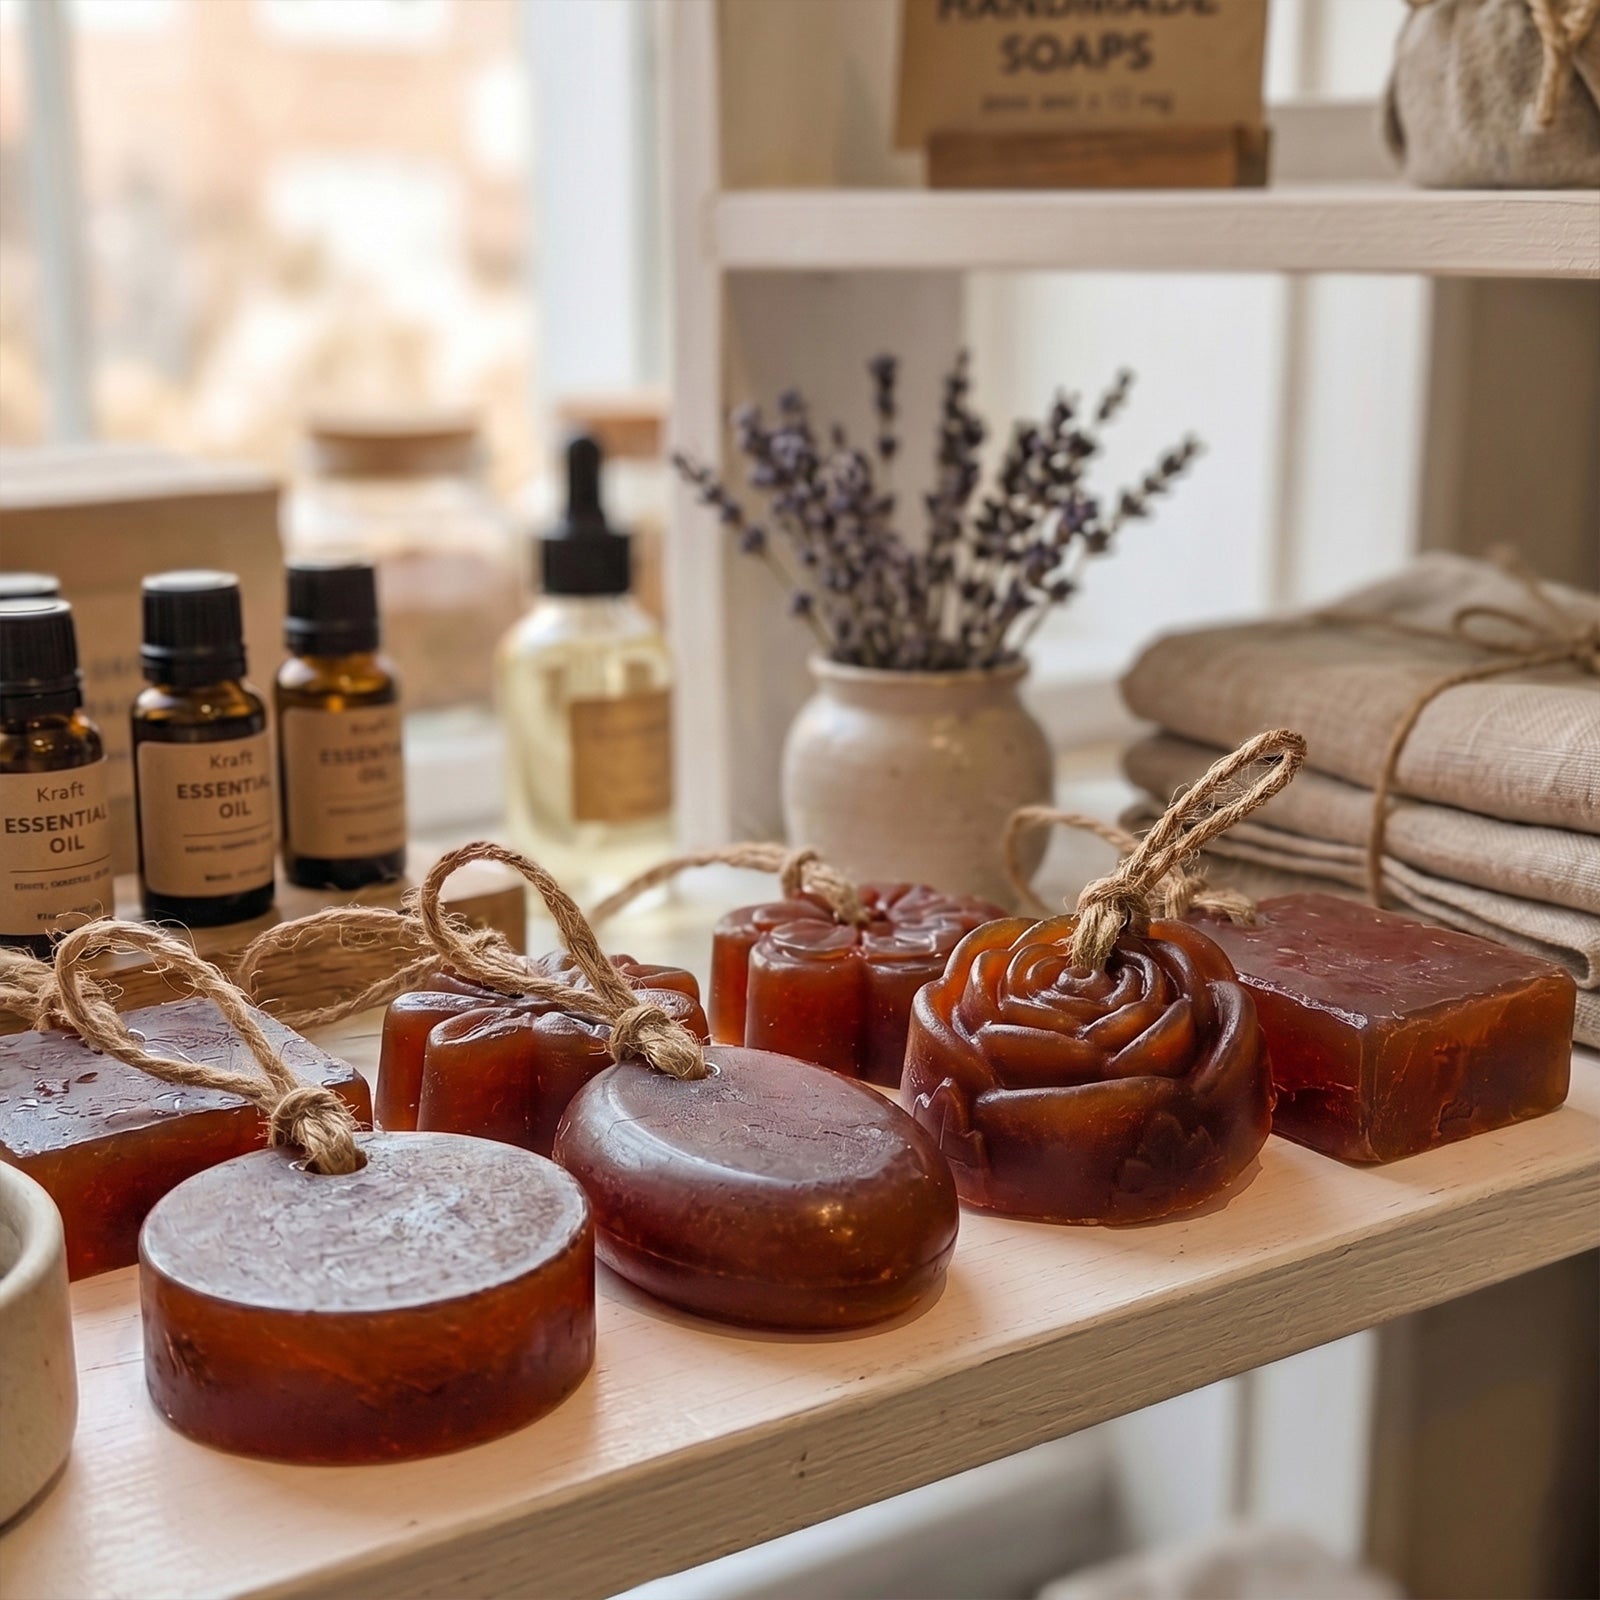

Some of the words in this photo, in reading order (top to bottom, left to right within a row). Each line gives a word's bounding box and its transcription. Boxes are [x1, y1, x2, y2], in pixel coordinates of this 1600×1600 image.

[1001, 31, 1153, 73] SOAPS
[210, 751, 253, 769] Kraft
[37, 781, 84, 802] Kraft
[176, 775, 270, 799] ESSENTIA
[5, 803, 106, 834] ESSENTIAL
[219, 801, 251, 819] OIL
[50, 835, 84, 853] OIL
